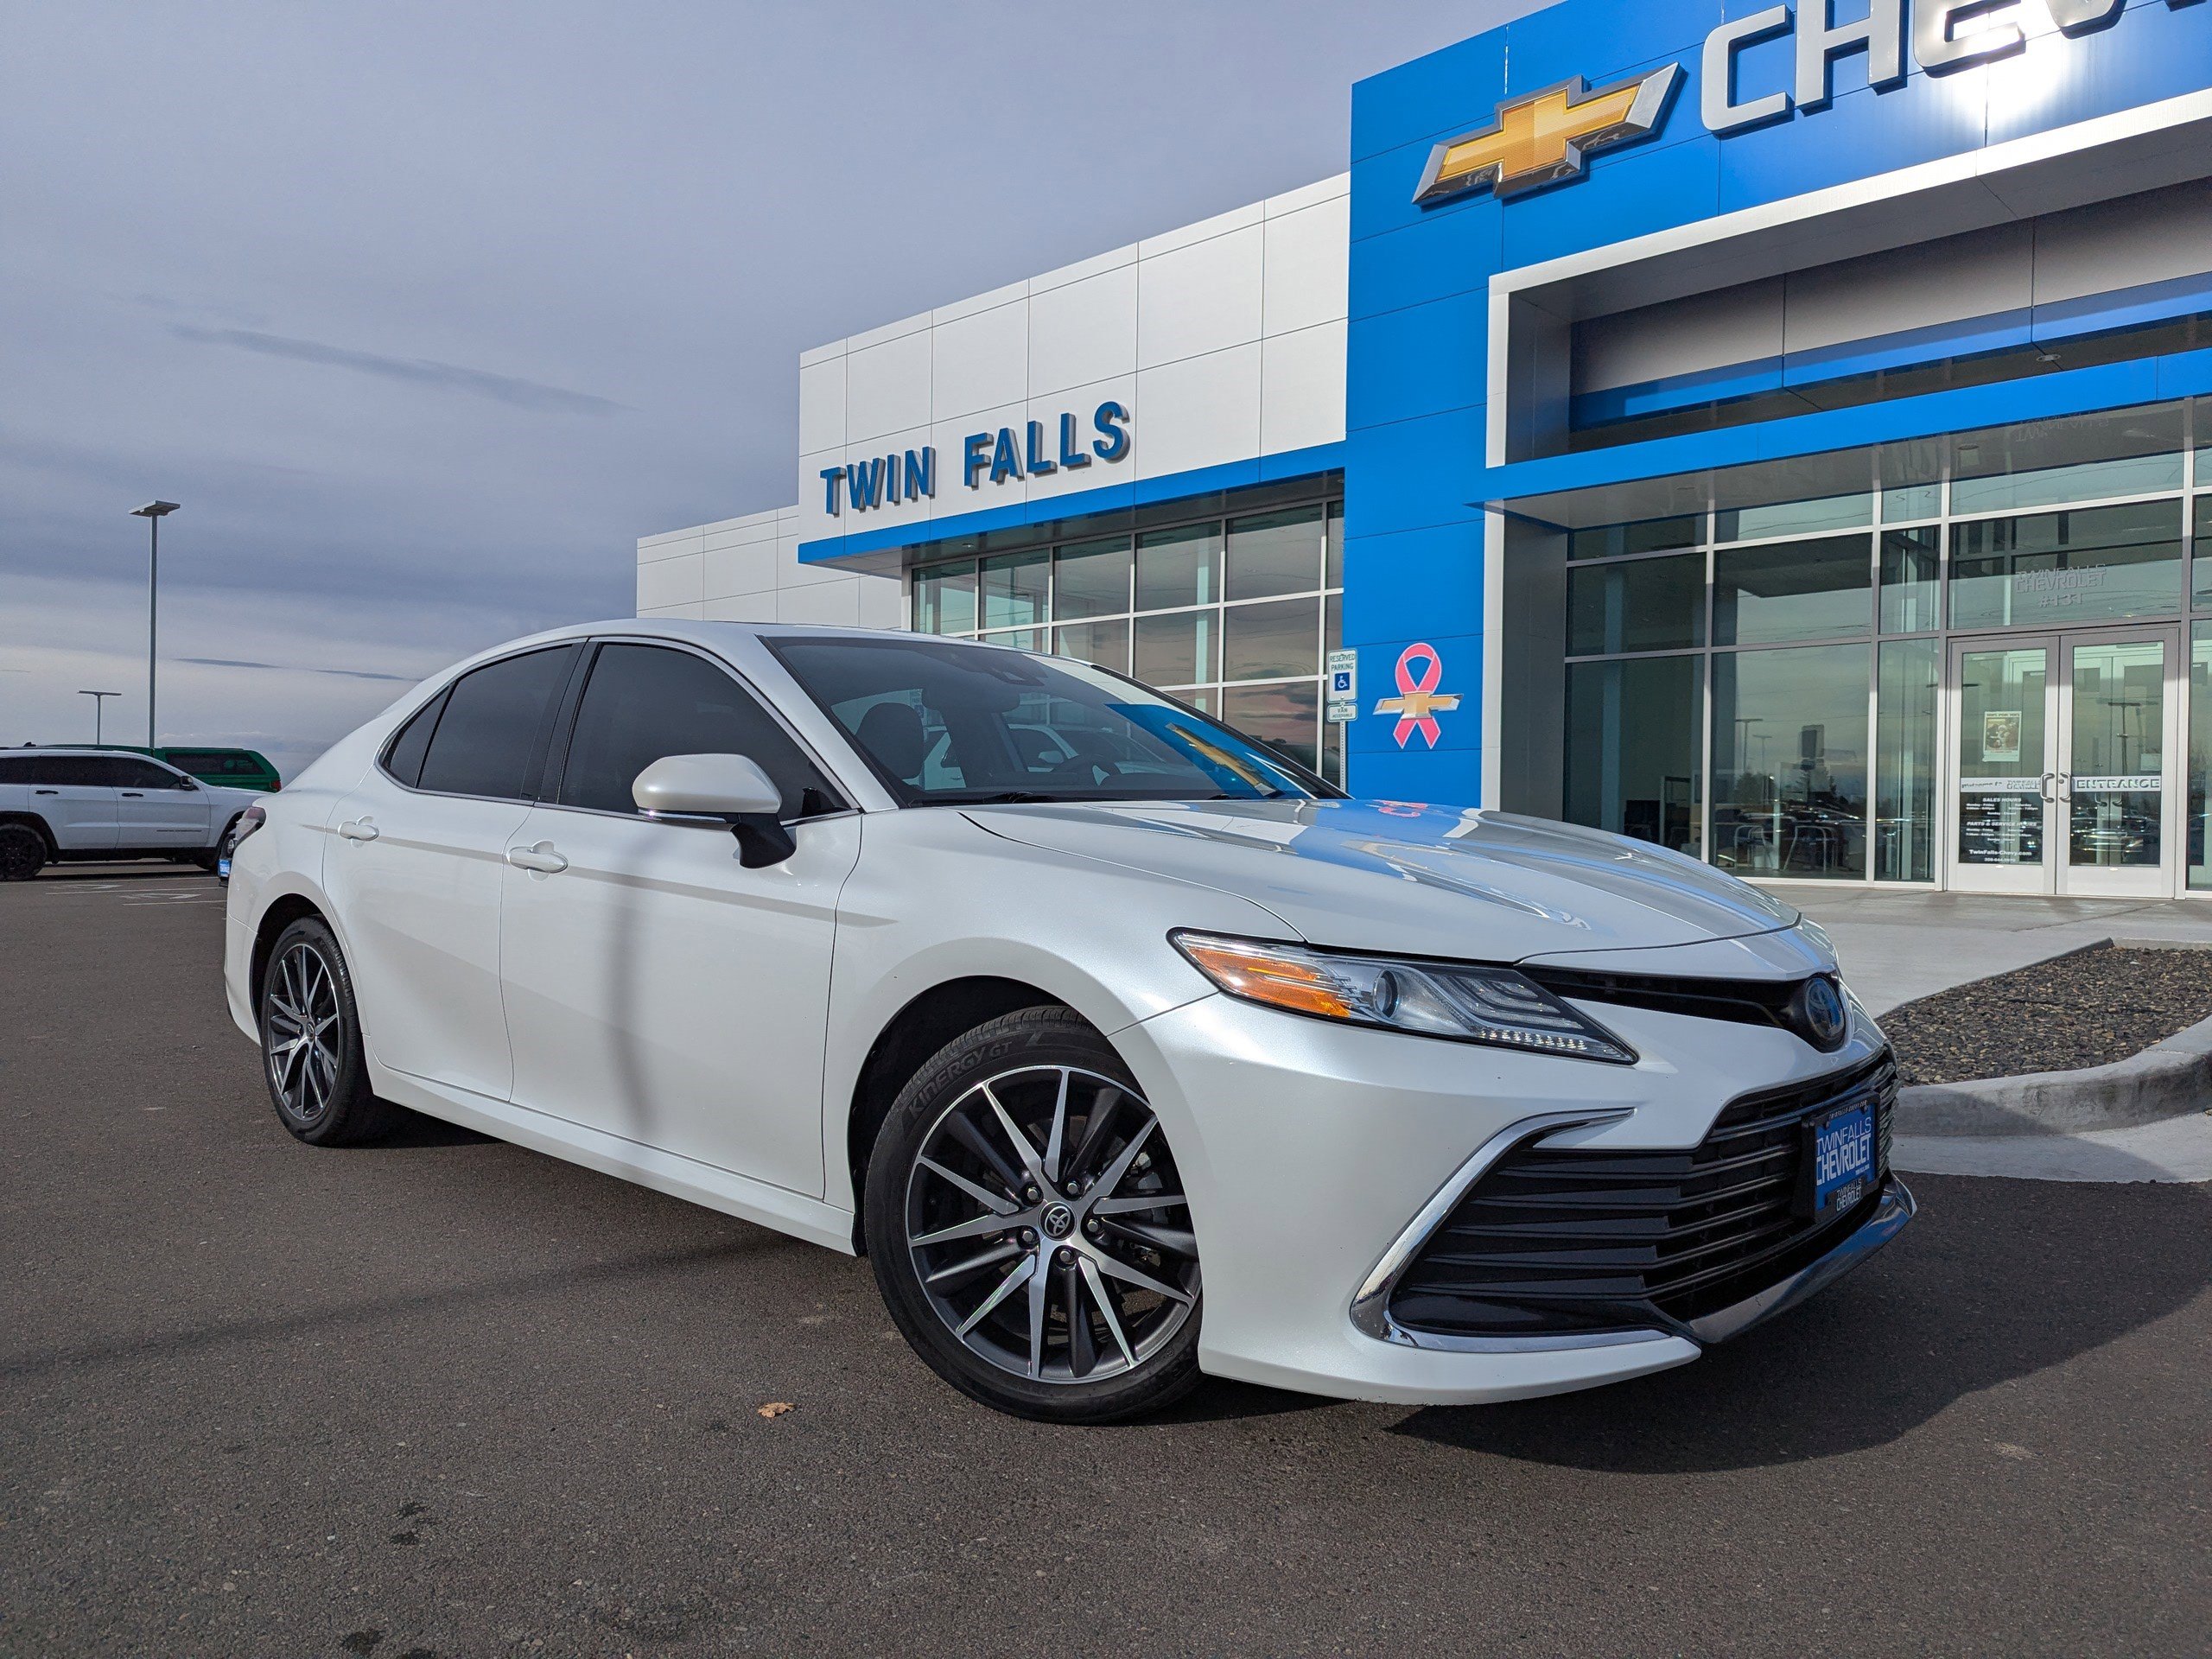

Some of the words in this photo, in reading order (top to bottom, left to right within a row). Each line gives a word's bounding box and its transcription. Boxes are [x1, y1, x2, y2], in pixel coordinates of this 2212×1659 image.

[820, 446, 935, 517] TWIN
[964, 401, 1130, 490] FALLS
[2016, 571, 2107, 594] CHEVROLET
[1330, 654, 1356, 663] RESERVED
[2076, 779, 2160, 789] ENTRANCE
[909, 1046, 987, 1120] KINERGY
[989, 1041, 1013, 1057] GT
[1816, 1116, 1872, 1156] TWINFALLS
[1816, 1133, 1872, 1186] CHEVROLET
